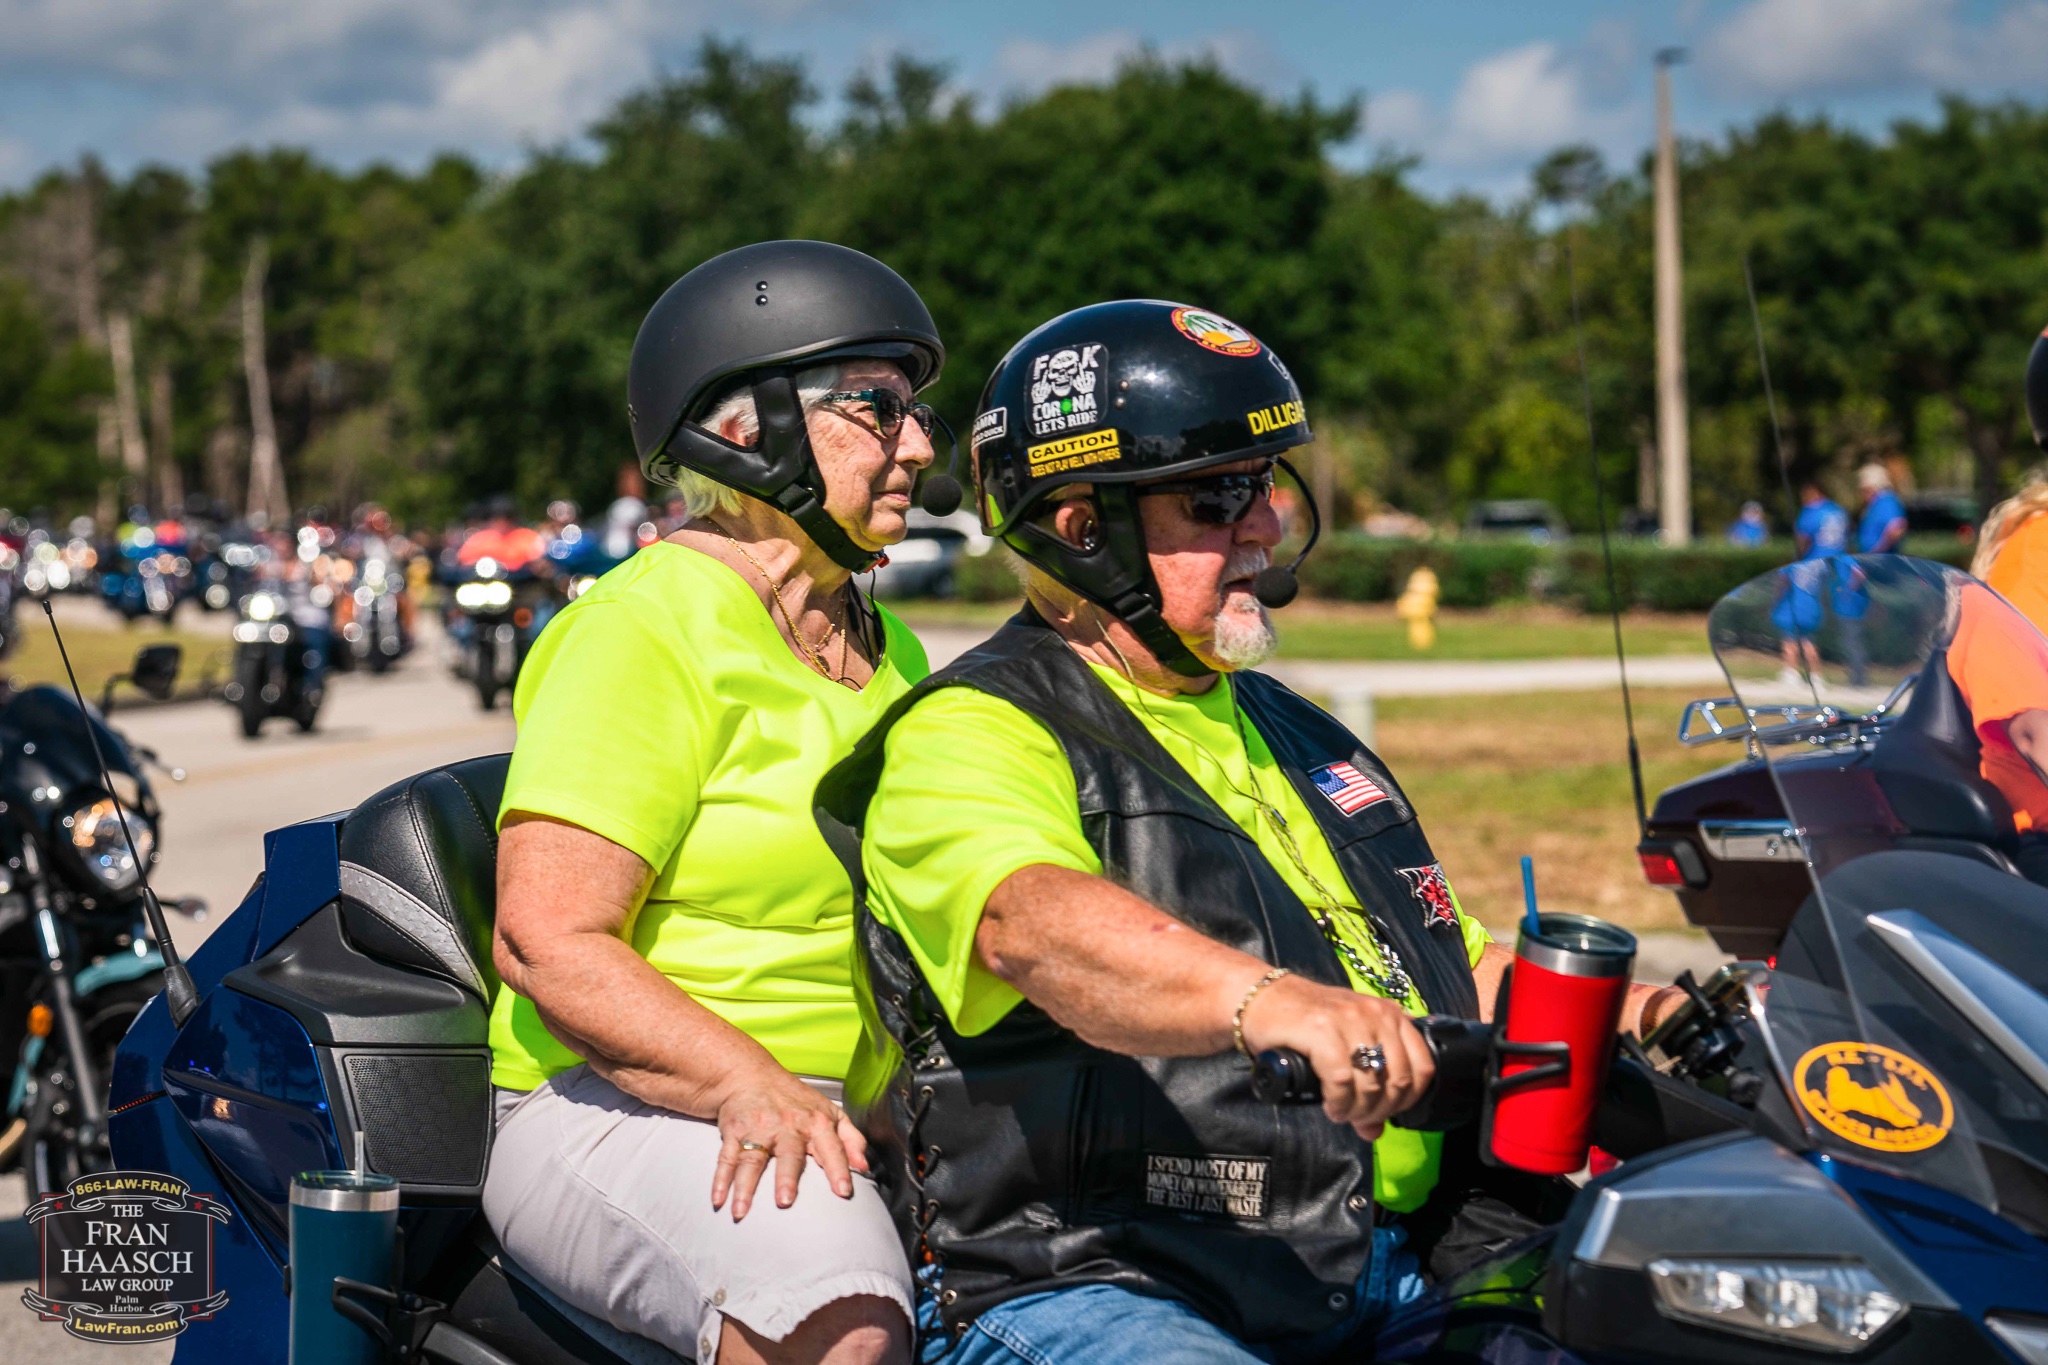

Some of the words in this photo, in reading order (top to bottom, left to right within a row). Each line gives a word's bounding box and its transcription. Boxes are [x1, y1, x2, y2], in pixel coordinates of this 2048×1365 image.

[1034, 417, 1066, 434] LETS
[1067, 411, 1098, 427] RIDE
[1032, 433, 1113, 459] CAUTION
[1154, 1156, 1191, 1174] SPEND
[1193, 1159, 1228, 1178] MOST
[1228, 1160, 1246, 1180] OF
[1246, 1162, 1267, 1181] MY
[1147, 1172, 1179, 1191] MONEY
[1180, 1175, 1195, 1193] ON
[1147, 1186, 1167, 1205] THE
[1168, 1190, 1193, 1210] REST
[1199, 1194, 1224, 1213] JUST
[1226, 1196, 1264, 1217] WASTE
